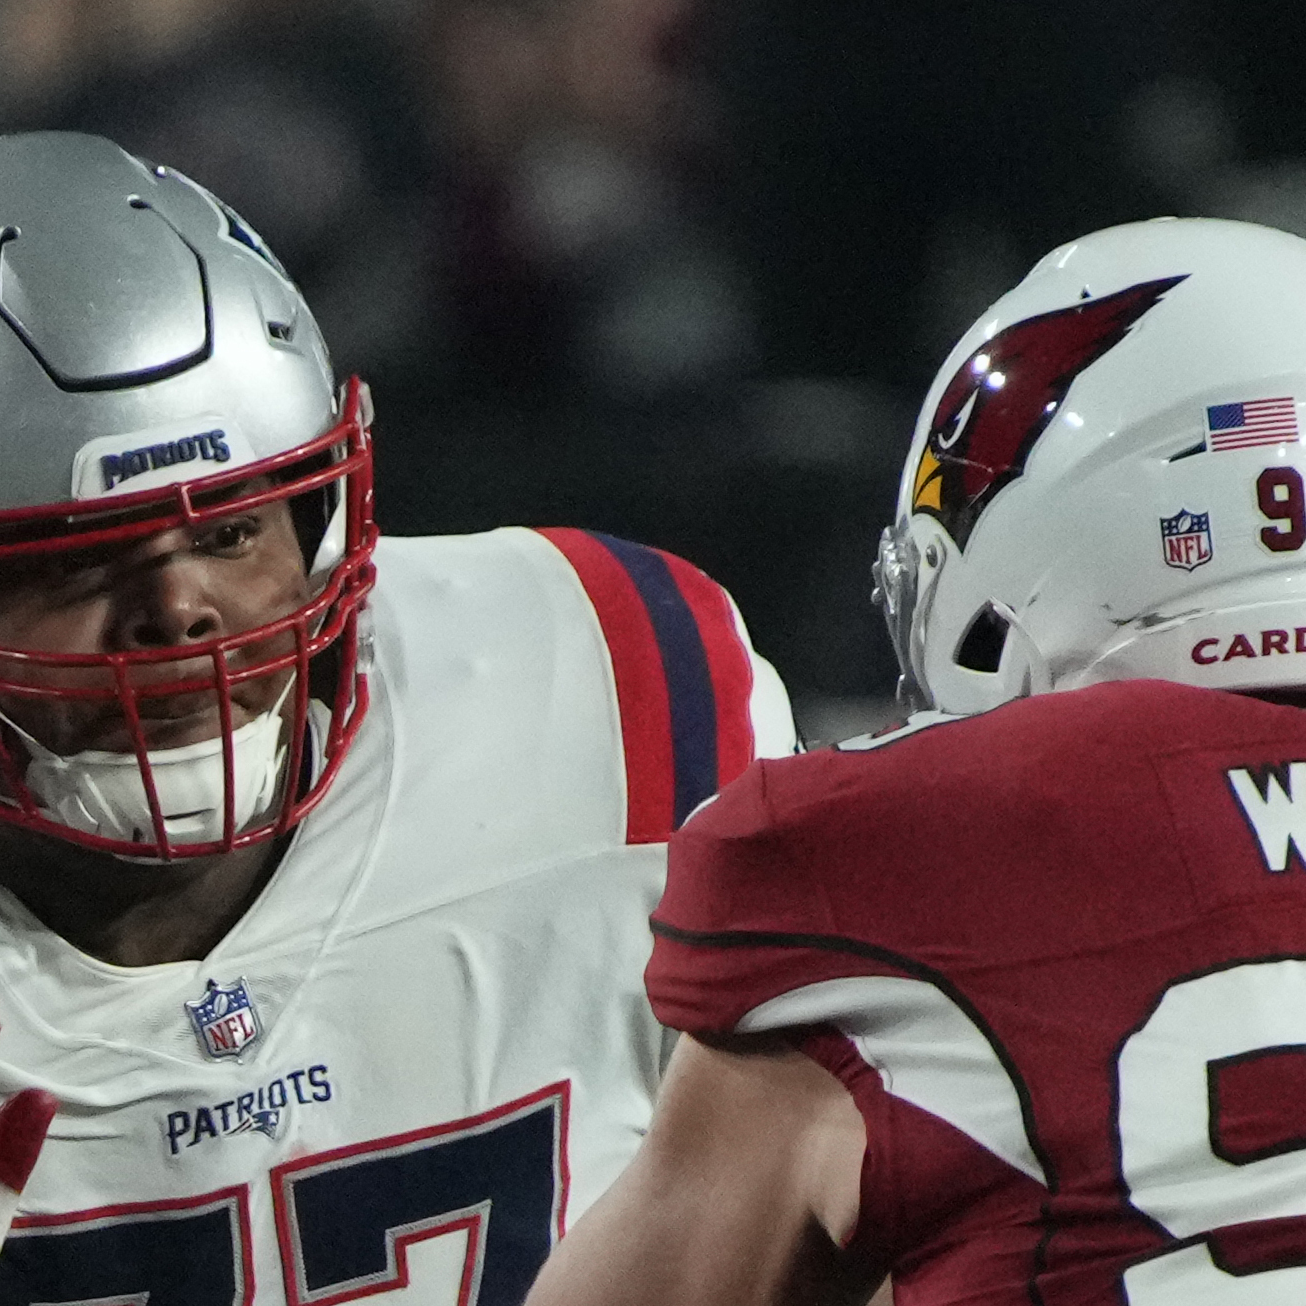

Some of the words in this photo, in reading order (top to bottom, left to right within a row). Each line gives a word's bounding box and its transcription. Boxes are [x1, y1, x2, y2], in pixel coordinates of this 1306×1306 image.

[101, 428, 231, 491] PATRIOTS
[1166, 534, 1210, 564] NFL
[207, 1013, 256, 1052] NFL
[166, 1064, 333, 1155] PATRIOTS
